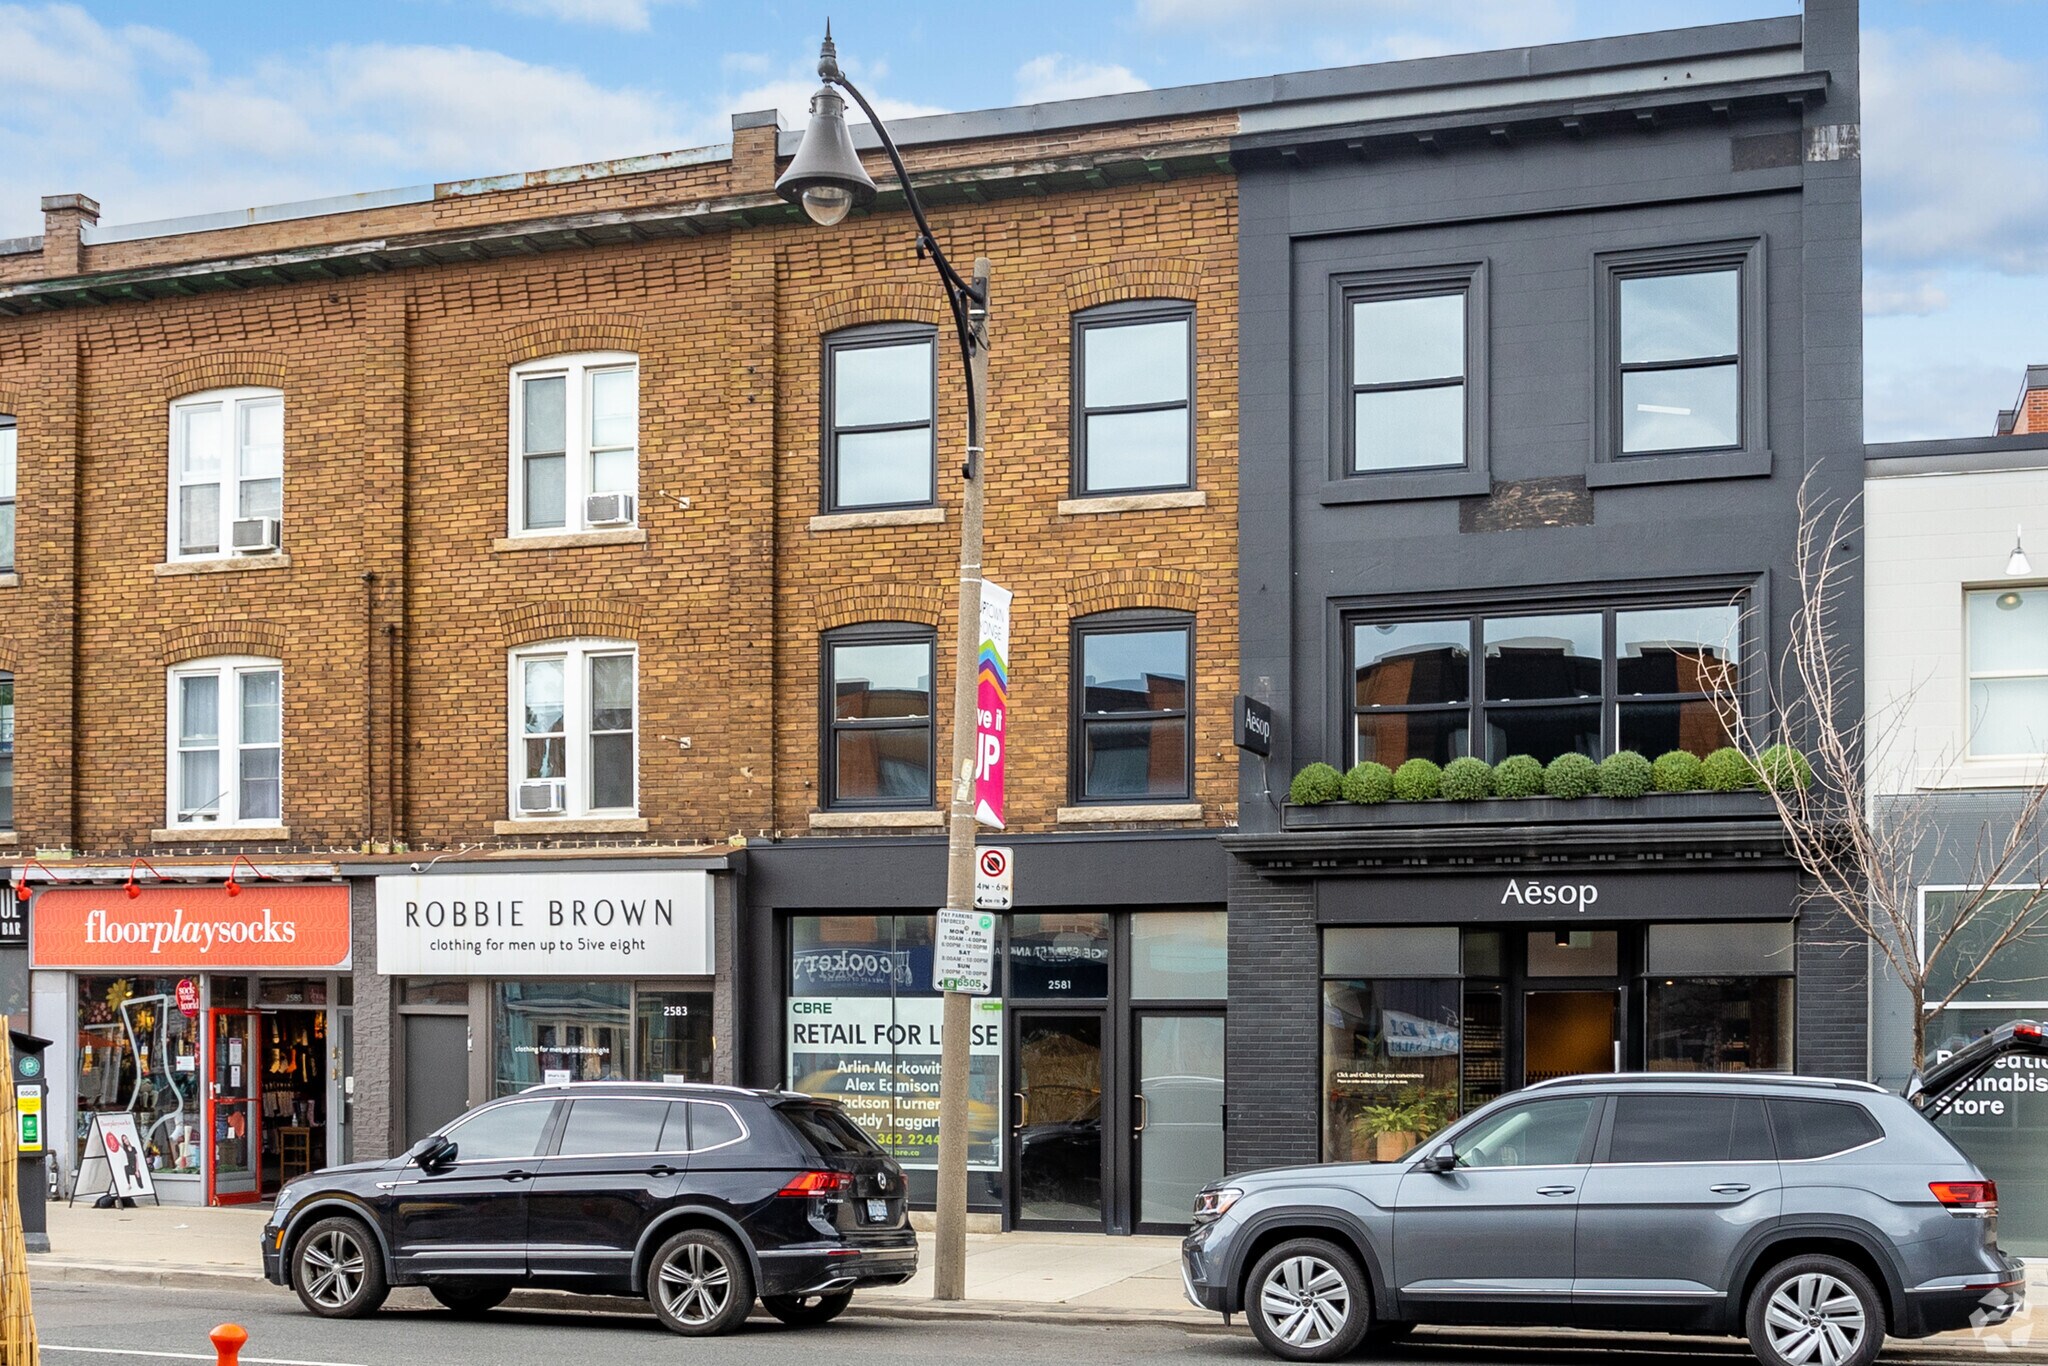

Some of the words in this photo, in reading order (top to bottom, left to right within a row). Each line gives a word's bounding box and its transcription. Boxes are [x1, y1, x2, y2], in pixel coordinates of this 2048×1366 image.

[980, 600, 1004, 622] PTOWN
[981, 620, 1002, 641] ONGE
[977, 708, 992, 728] ve
[996, 708, 1002, 731] it
[1246, 708, 1269, 744] Aēsop
[1500, 879, 1598, 912] Aēsop
[406, 901, 524, 927] ROBBIE
[550, 900, 672, 926] BROWN
[2, 922, 21, 935] BAR
[84, 908, 296, 953] floorplaysocks
[430, 938, 481, 955] clothing
[486, 938, 504, 950] for
[508, 940, 536, 950] men
[540, 940, 556, 954] up
[560, 940, 573, 950] to
[578, 938, 605, 950] 5ive
[610, 938, 645, 954] eight
[957, 979, 981, 987] 6505
[1048, 980, 1071, 990] 2581
[663, 1006, 688, 1016] 2583
[792, 1003, 832, 1014] CBRE
[794, 1024, 866, 1044] RETAIL
[874, 1024, 921, 1045] FOR
[930, 1025, 998, 1045] LSE
[515, 1046, 538, 1054] clothing
[593, 1046, 609, 1055] eight
[837, 1060, 870, 1073] Arlin
[874, 1061, 942, 1074] Markowit
[845, 1077, 875, 1091] Alex
[879, 1079, 942, 1092] Edmison
[1954, 1072, 2048, 1092] nnabis
[894, 1096, 941, 1110] Turner
[1936, 1096, 2004, 1115] Store
[846, 1113, 883, 1130] eddy
[878, 1133, 903, 1145] 362
